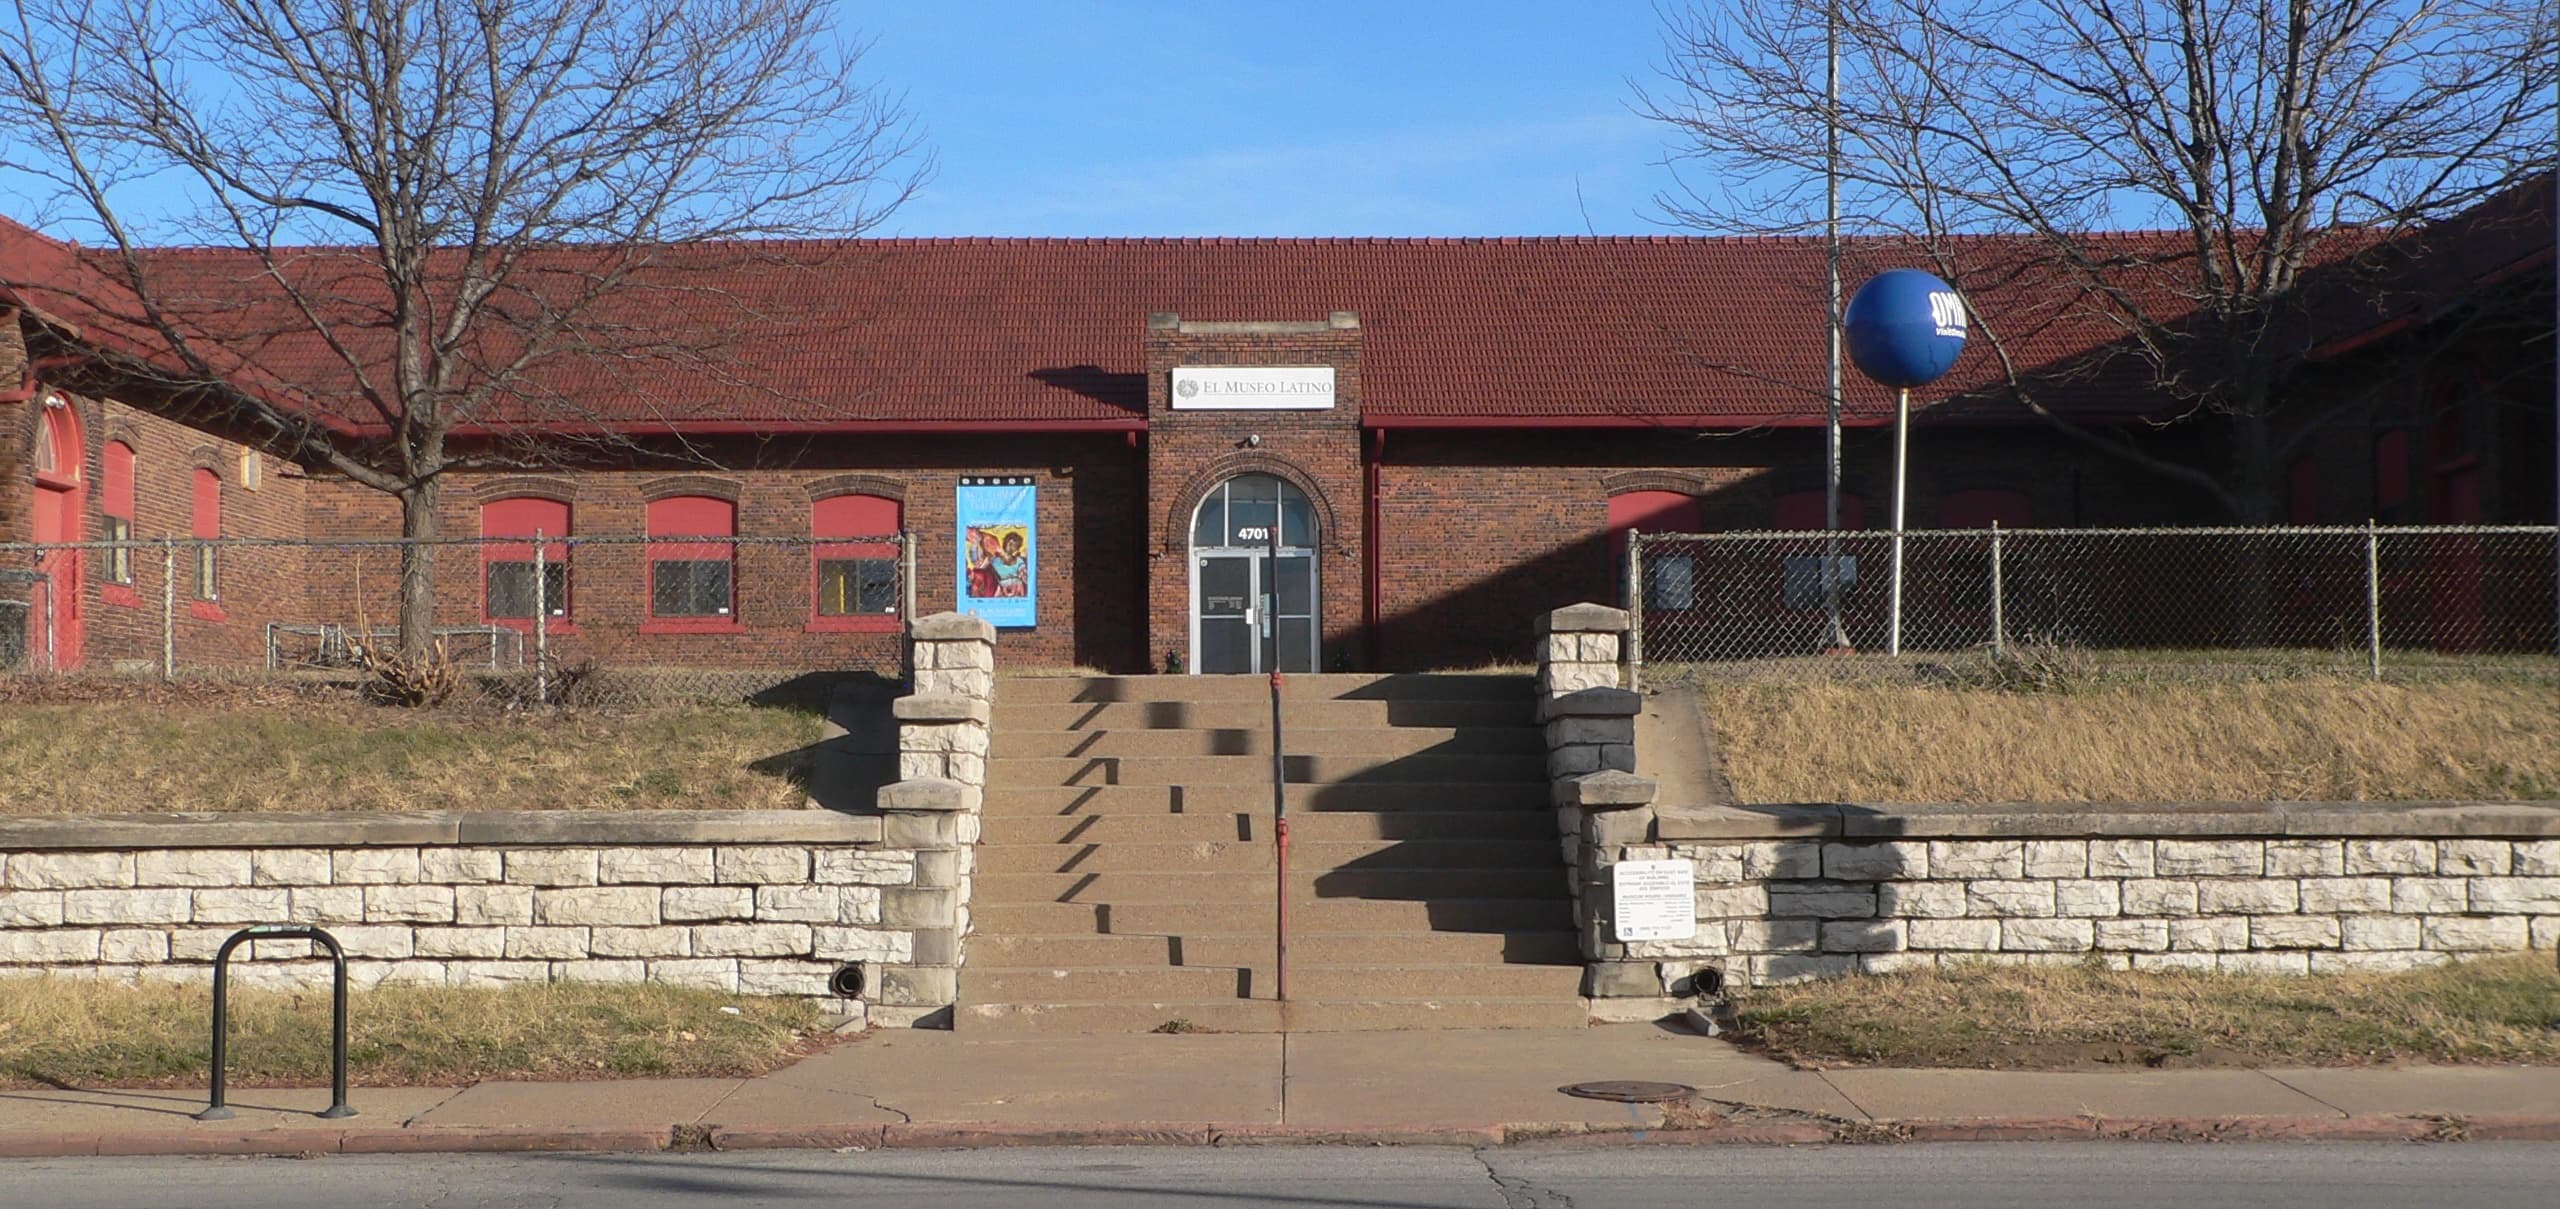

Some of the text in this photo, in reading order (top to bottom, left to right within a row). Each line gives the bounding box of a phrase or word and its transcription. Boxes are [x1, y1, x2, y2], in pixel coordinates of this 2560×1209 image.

[1204, 381, 1333, 393] EL MUSEO LATINO
[1238, 527, 1269, 540] 4701
